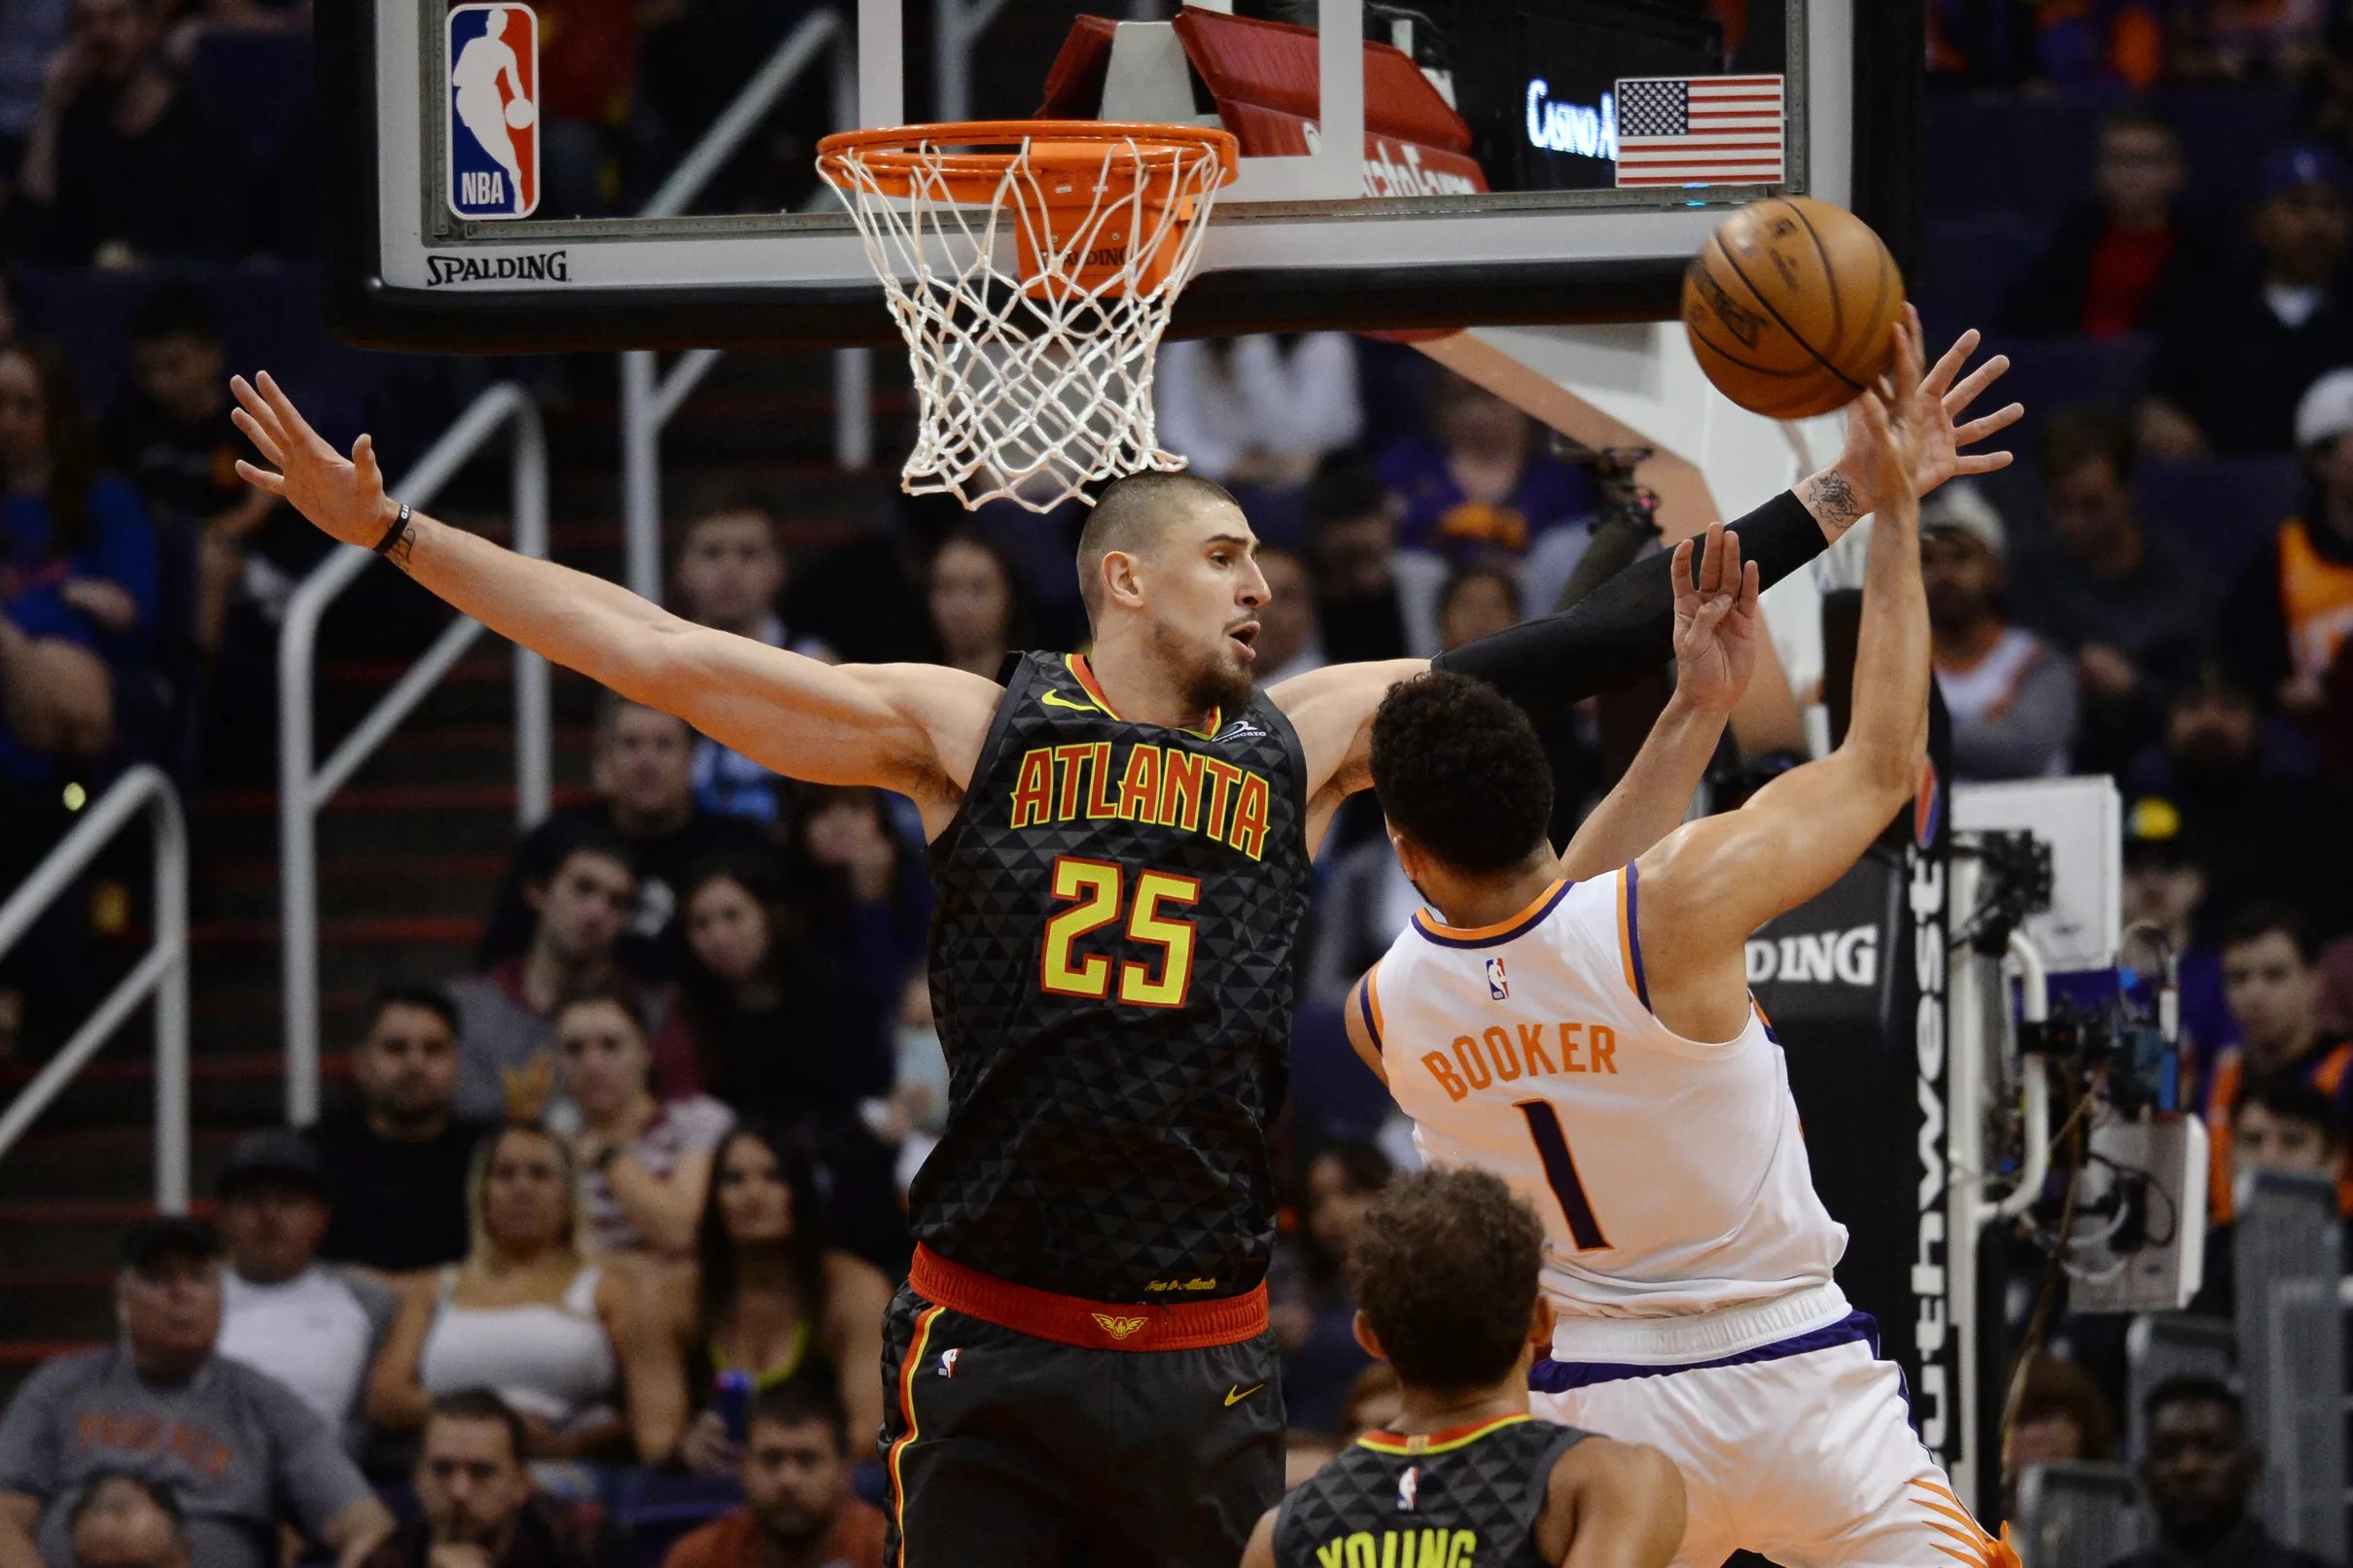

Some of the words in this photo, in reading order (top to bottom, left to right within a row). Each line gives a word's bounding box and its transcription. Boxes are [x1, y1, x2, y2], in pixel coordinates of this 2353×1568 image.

[462, 172, 505, 205] NBA
[427, 250, 567, 287] SPALDING
[1009, 742, 1271, 862] ATLANTA
[1039, 855, 1202, 1009] 25
[1744, 923, 1879, 987] DING
[1421, 1022, 1618, 1102] BOOKER
[1512, 1098, 1614, 1252] 1
[1910, 857, 1946, 1473] uthwest
[1316, 1528, 1477, 1568] YOUNG
